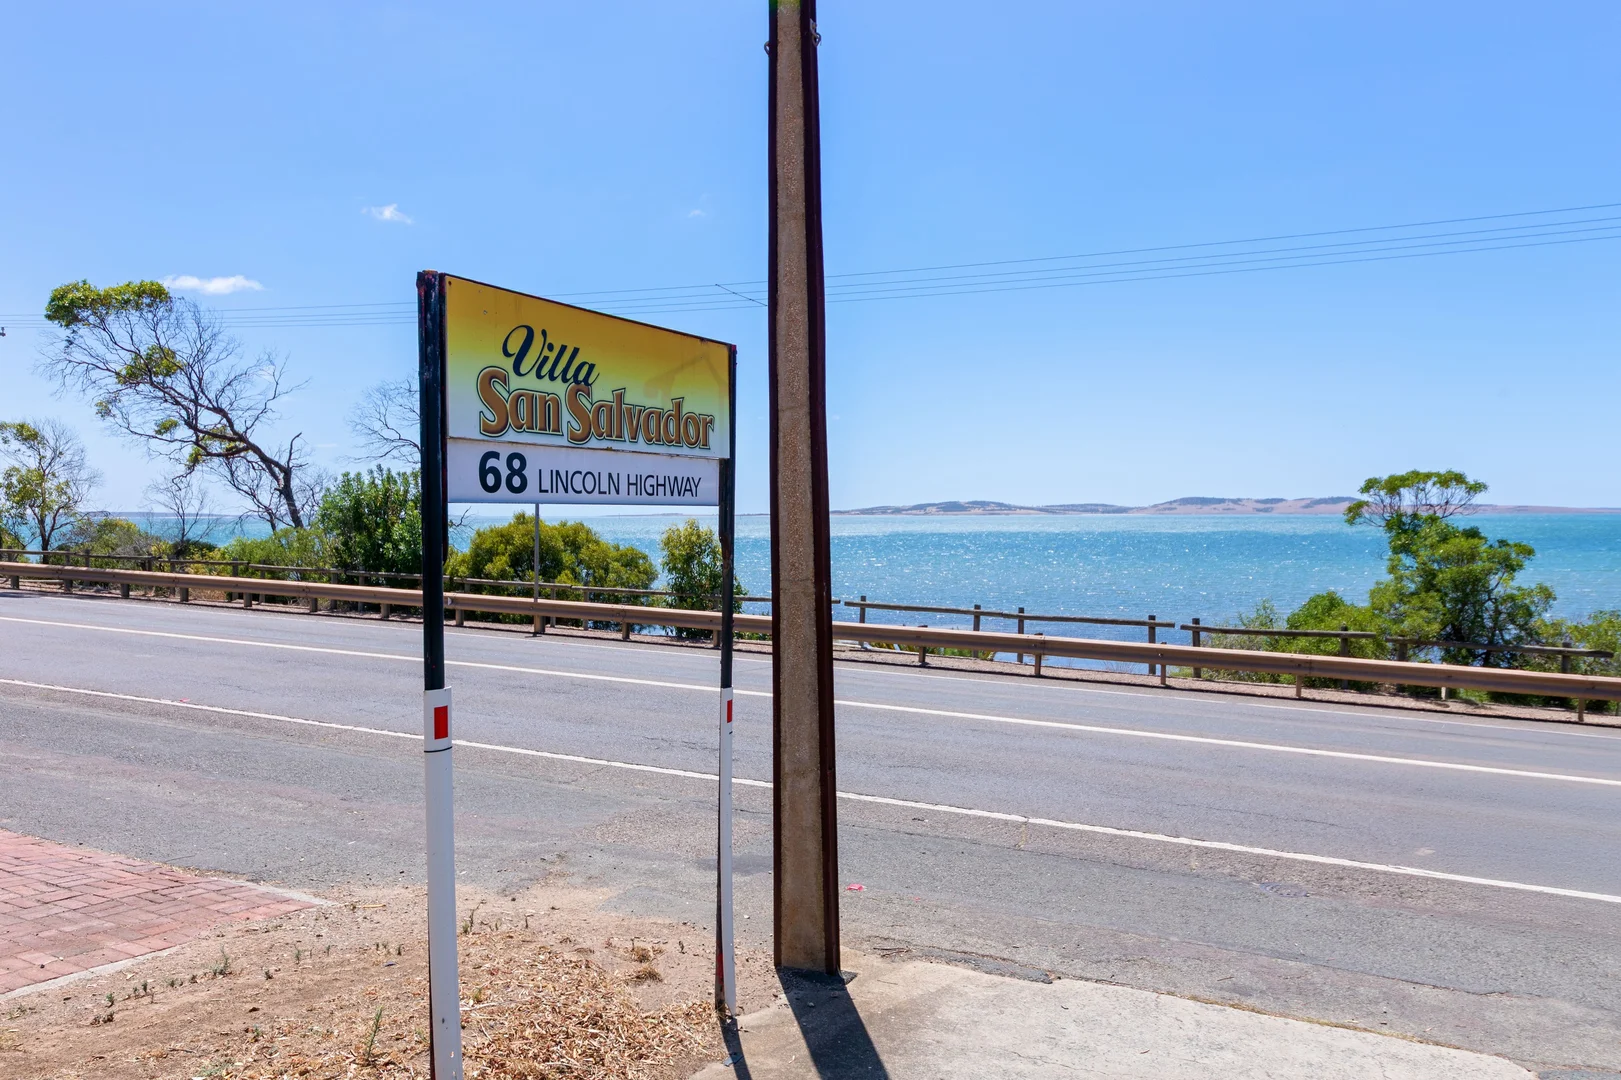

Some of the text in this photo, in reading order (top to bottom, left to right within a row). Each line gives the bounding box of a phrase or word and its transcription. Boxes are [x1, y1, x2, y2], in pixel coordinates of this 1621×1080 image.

[502, 324, 600, 386] Villa
[476, 365, 715, 450] San Salvador
[478, 450, 702, 498] 68 LINCOLN HIGHWAY
